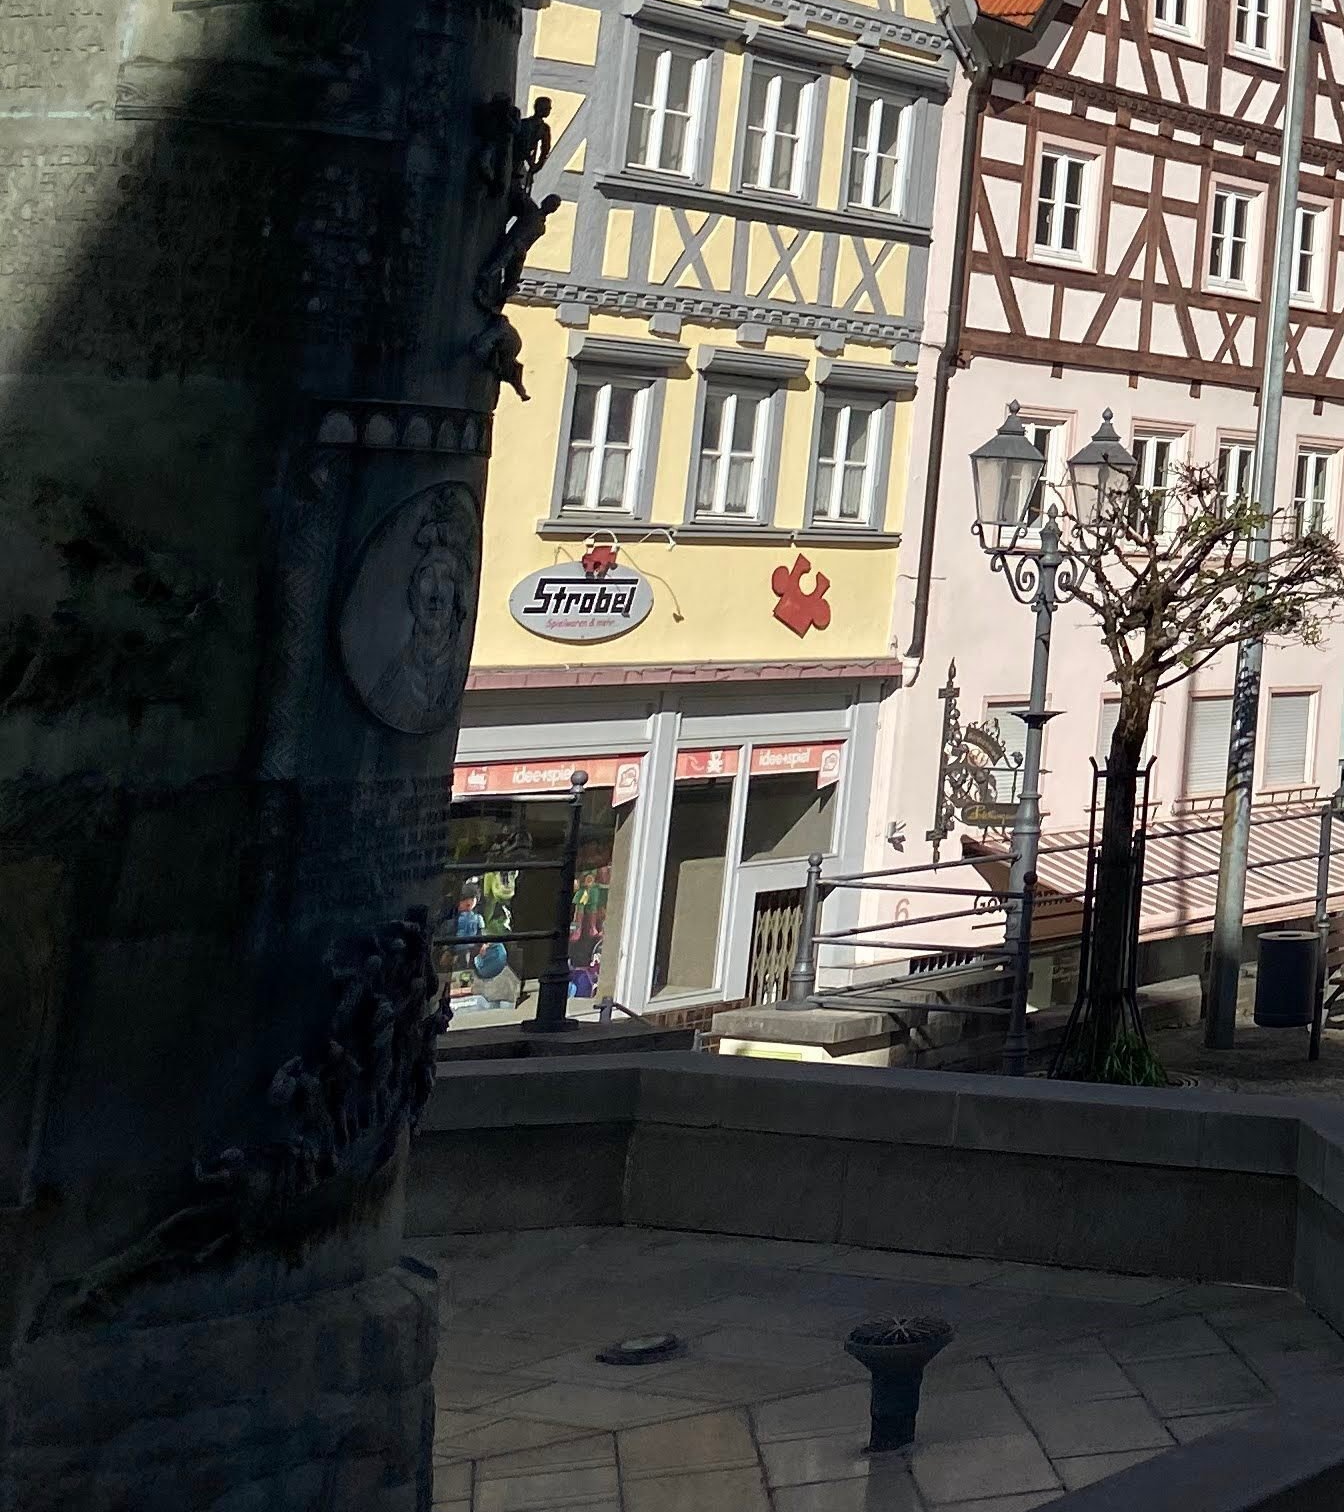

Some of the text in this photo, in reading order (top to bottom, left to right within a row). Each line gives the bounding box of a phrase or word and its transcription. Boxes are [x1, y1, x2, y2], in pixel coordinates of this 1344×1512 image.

[522, 578, 639, 614] Strobel
[545, 618, 587, 630] Spielwaren
[588, 618, 596, 627] &
